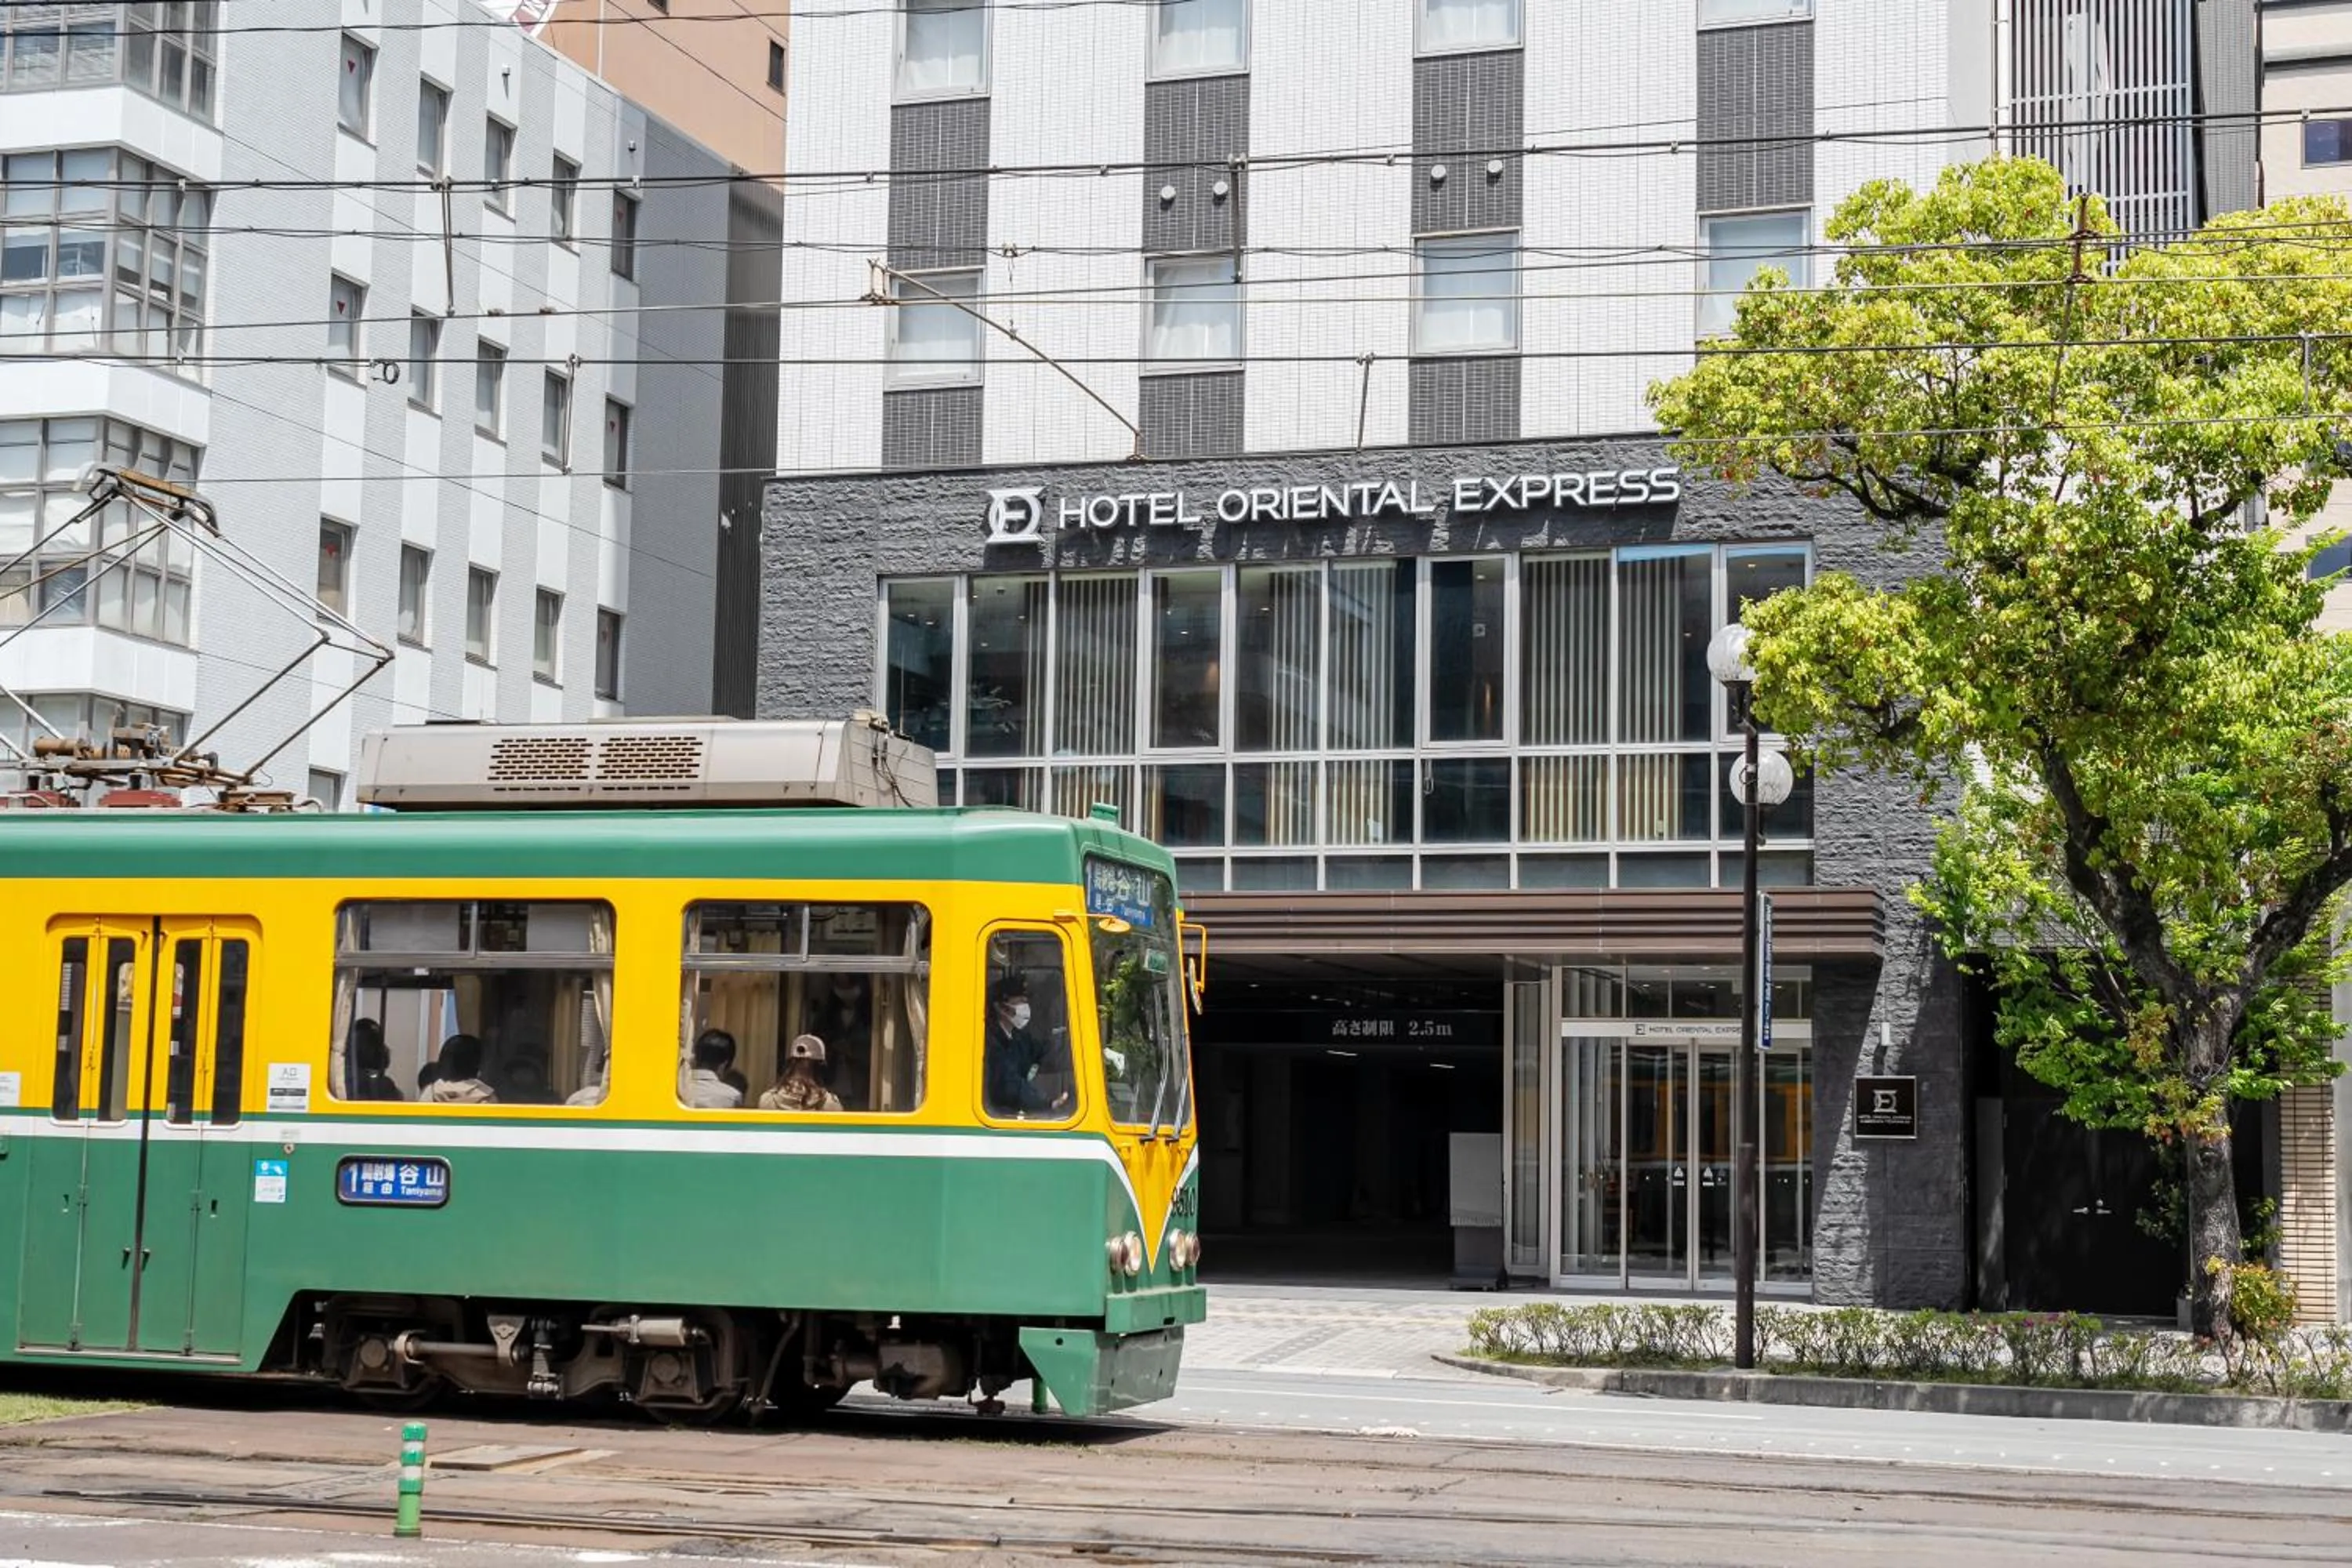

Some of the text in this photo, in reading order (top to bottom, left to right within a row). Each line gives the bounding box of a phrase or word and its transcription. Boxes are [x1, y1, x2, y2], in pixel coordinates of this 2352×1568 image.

[1058, 492, 1202, 529] HOTEL
[1217, 480, 1436, 523] ORIENTAL
[1451, 466, 1681, 511] EXPRESS
[1408, 1020, 1453, 1036] 2.5m
[399, 1163, 445, 1186] 谷山
